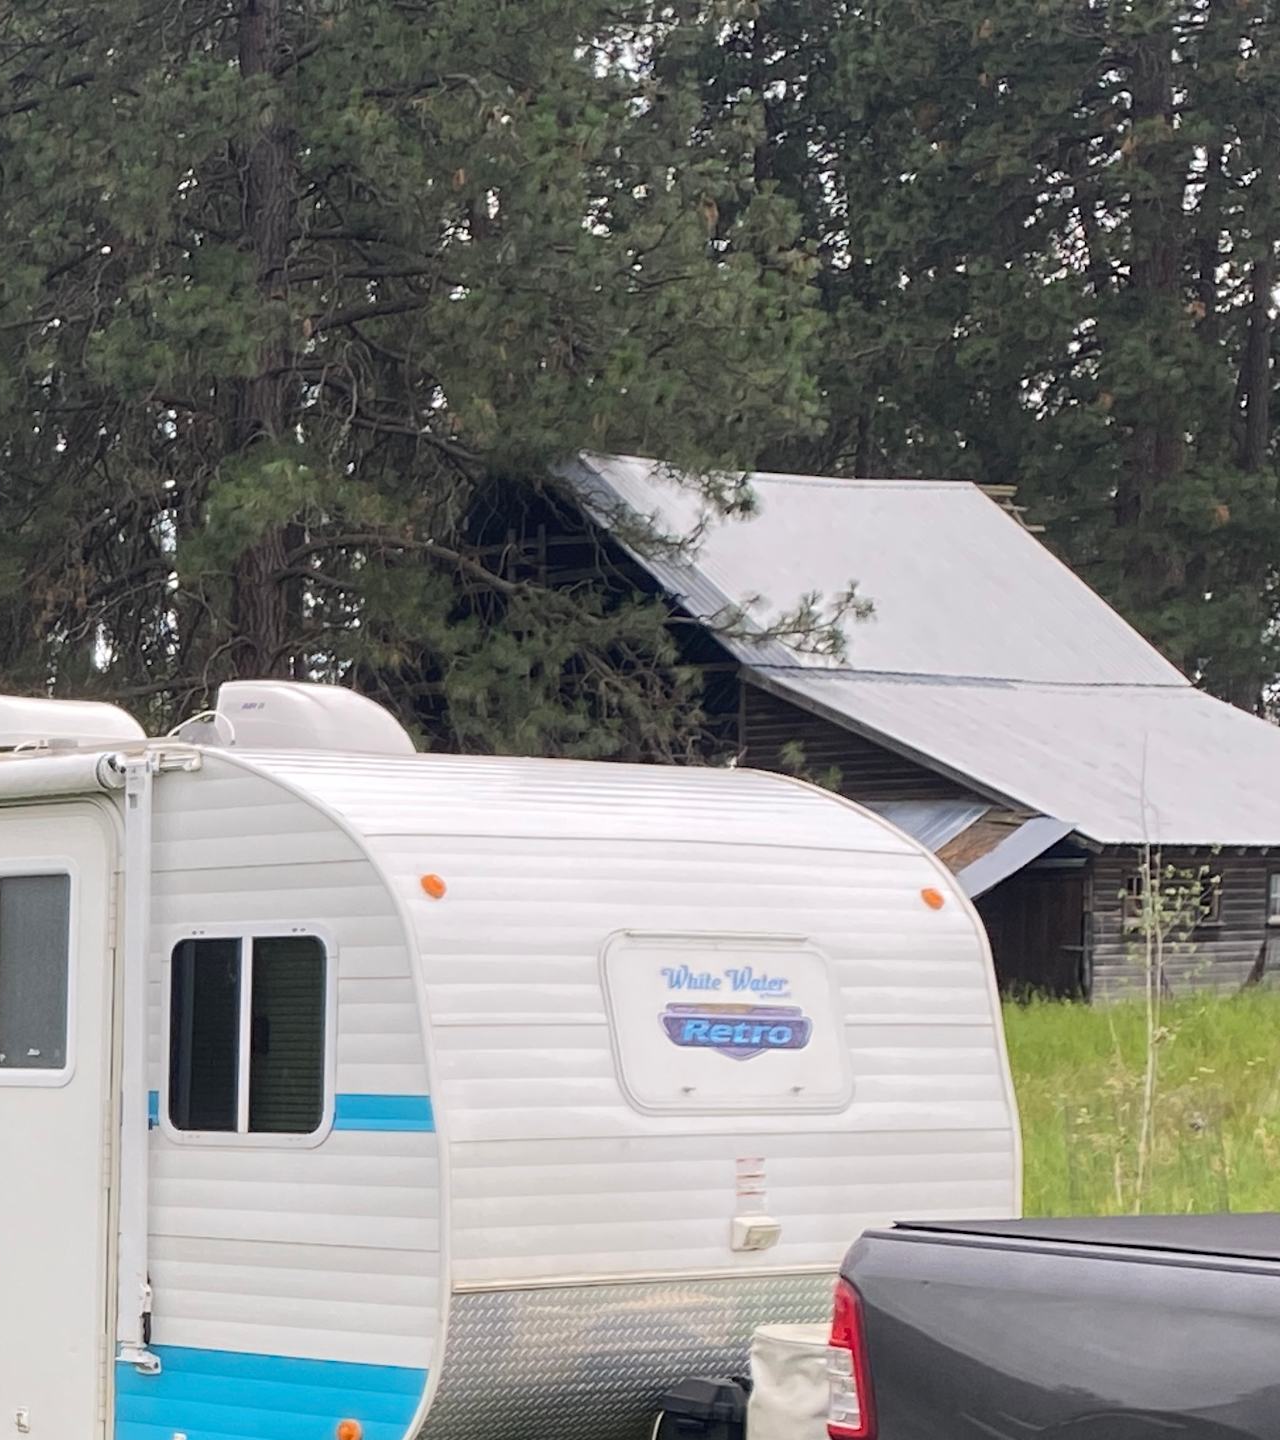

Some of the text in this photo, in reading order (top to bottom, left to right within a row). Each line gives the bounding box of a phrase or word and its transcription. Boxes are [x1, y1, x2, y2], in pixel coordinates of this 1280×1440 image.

[661, 964, 788, 991] White Water
[682, 1018, 793, 1044] Retro
